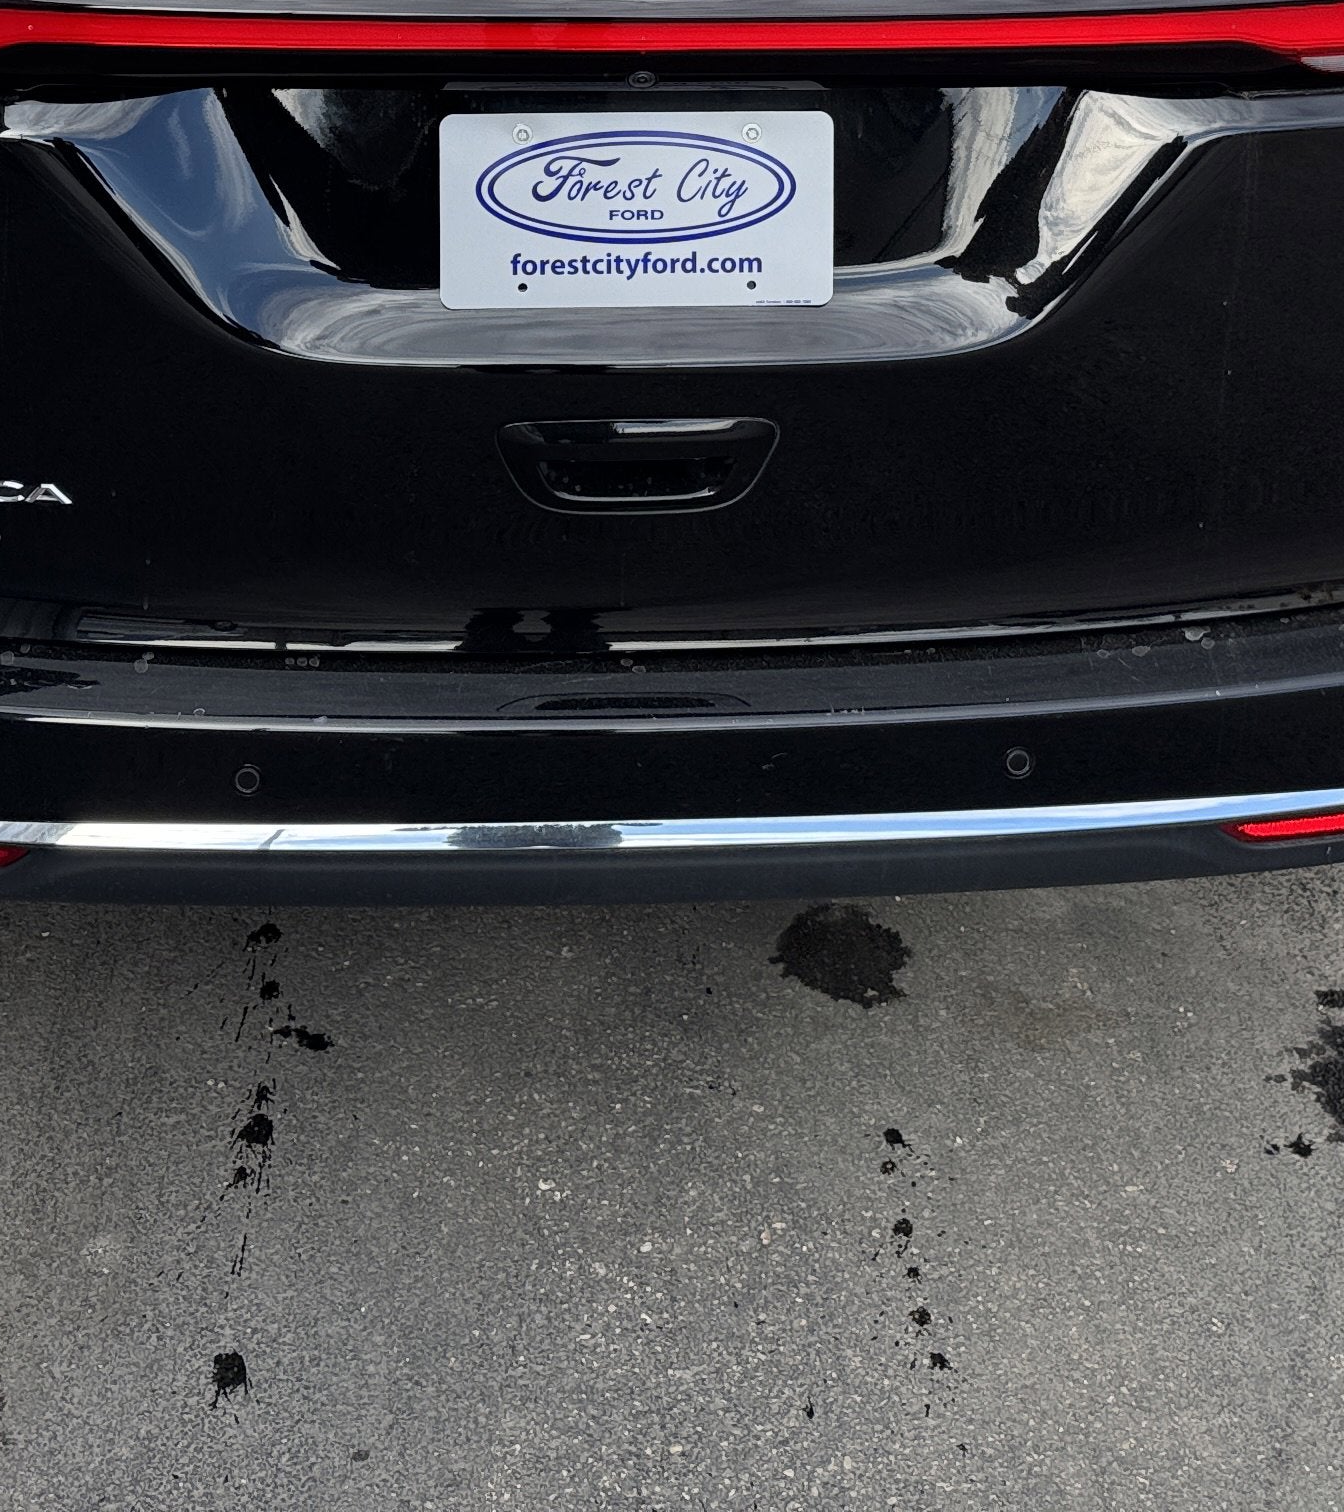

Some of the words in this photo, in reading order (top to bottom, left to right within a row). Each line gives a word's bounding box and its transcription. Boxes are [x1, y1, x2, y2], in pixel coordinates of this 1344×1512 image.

[531, 155, 662, 203] Forest
[676, 158, 749, 218] City
[608, 209, 664, 221] FORD
[510, 251, 763, 281] forestcityford.com
